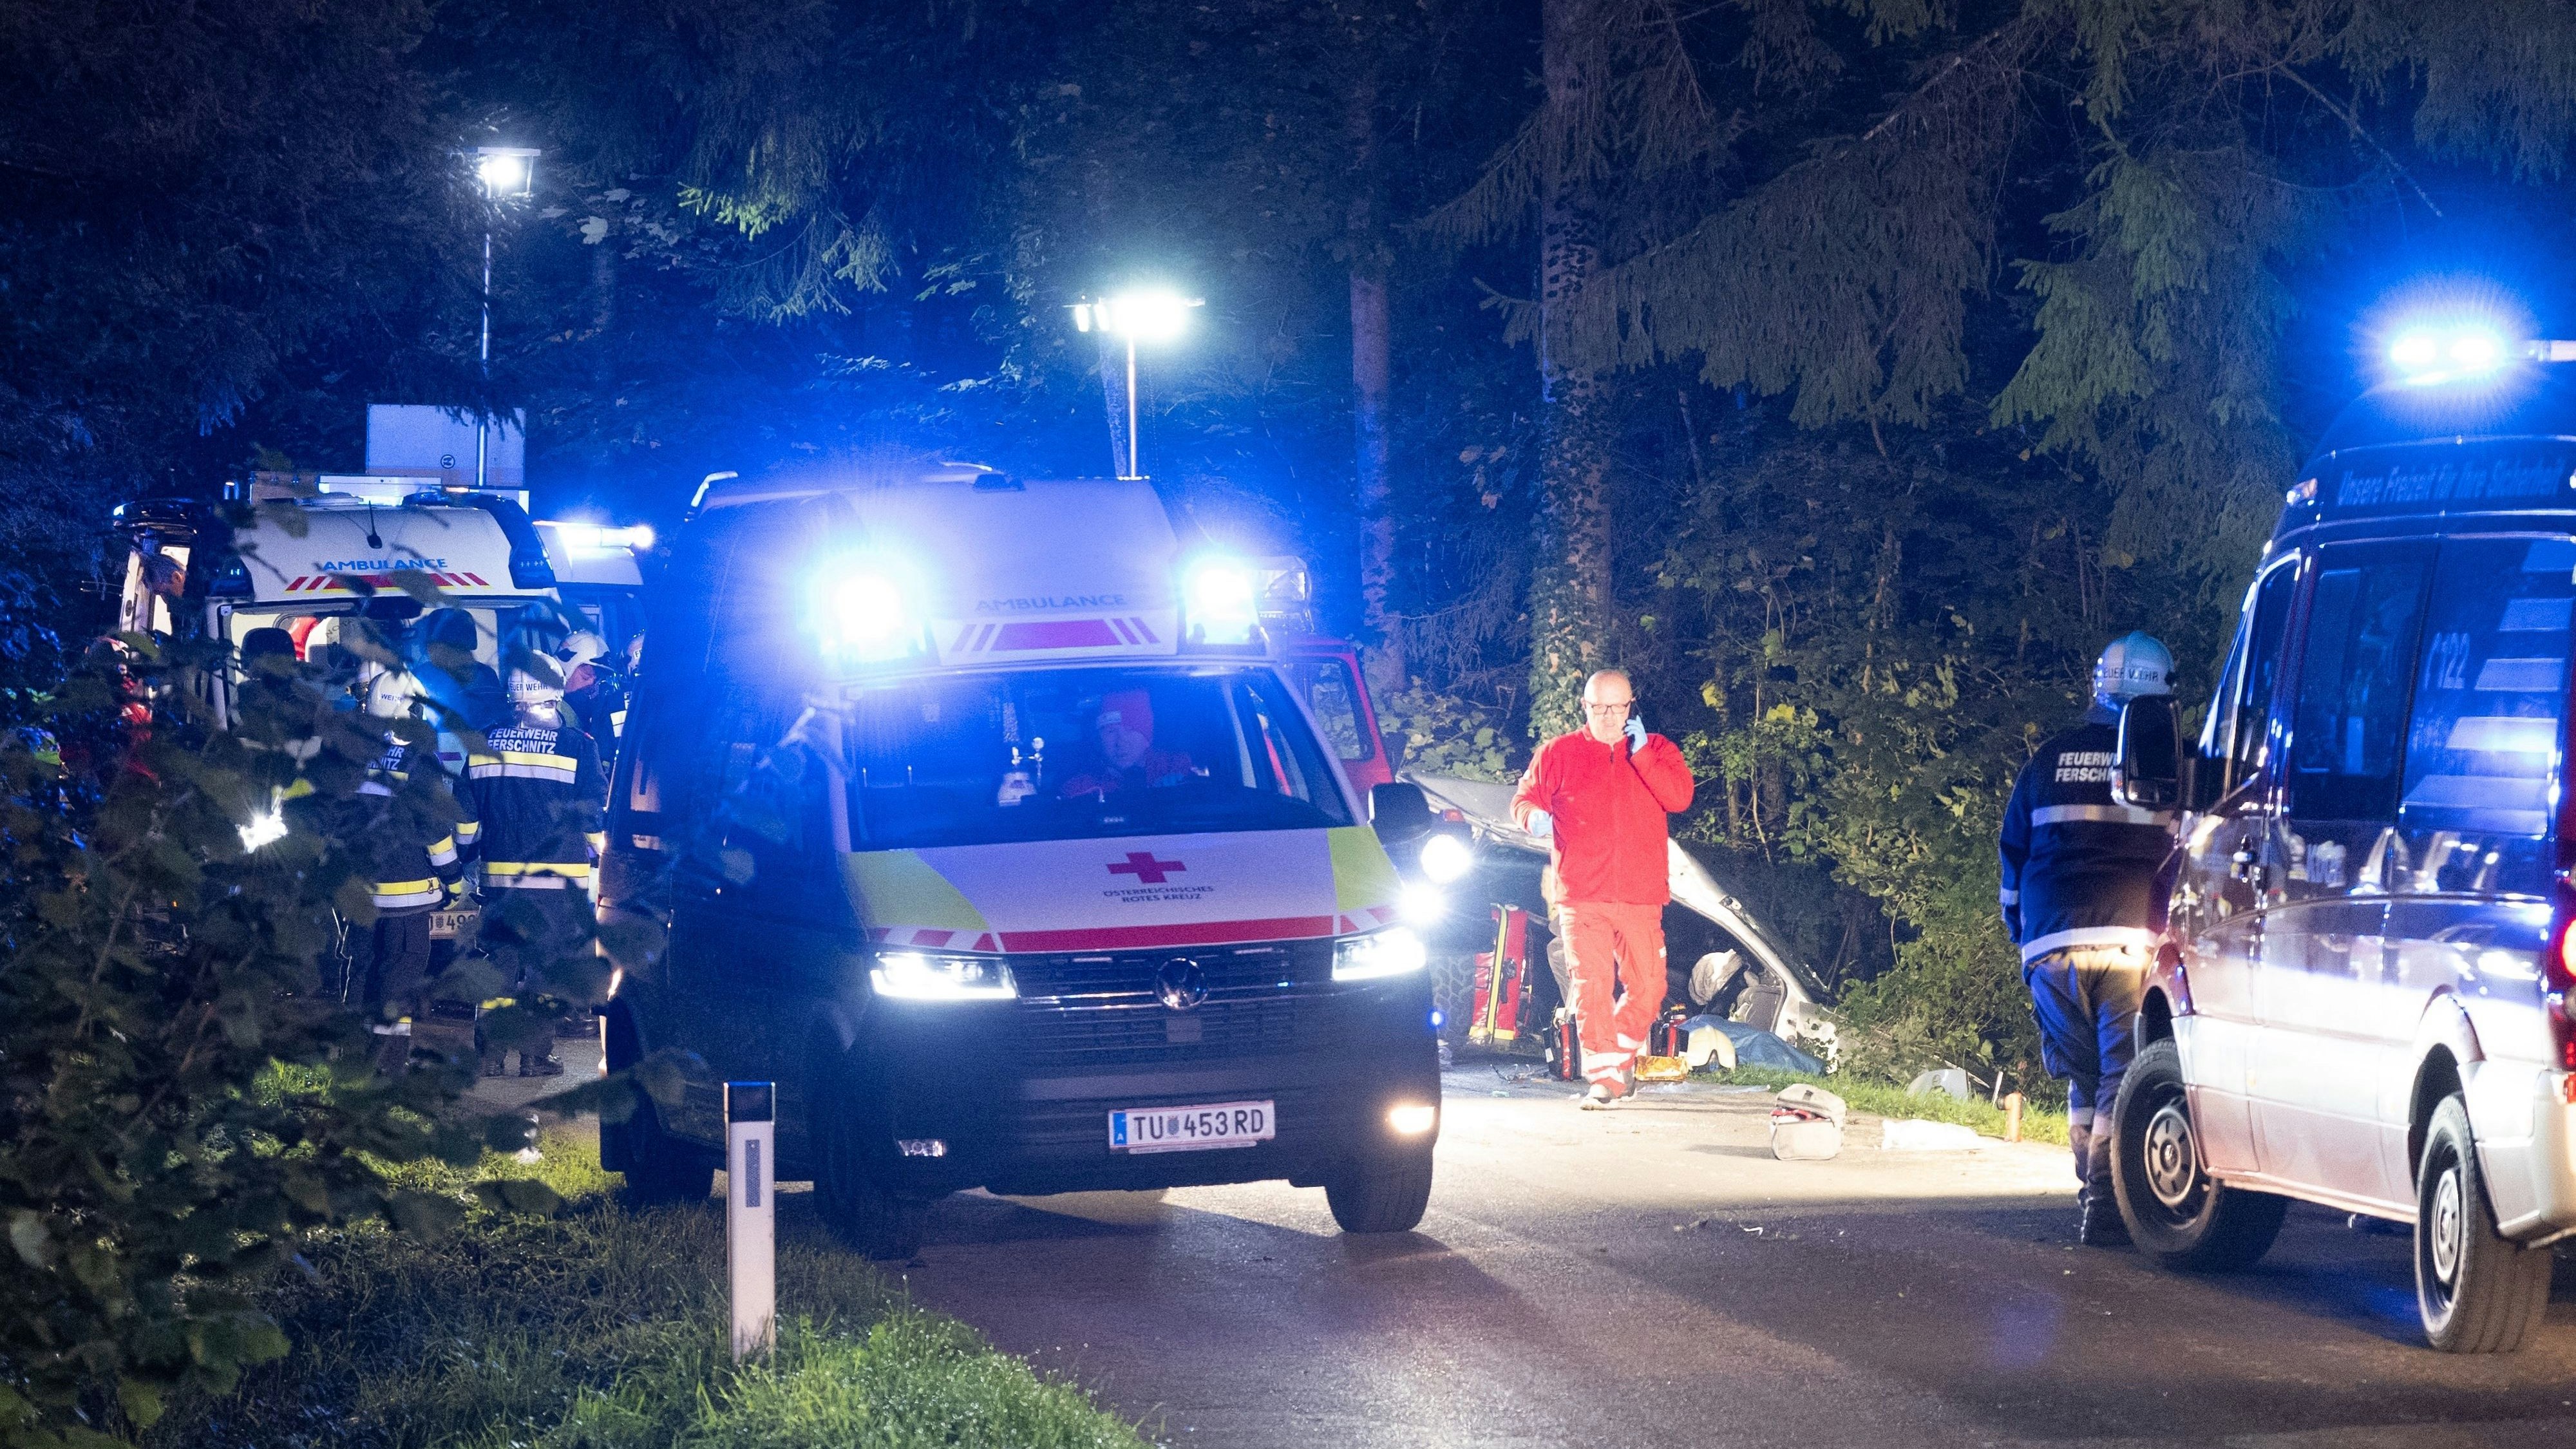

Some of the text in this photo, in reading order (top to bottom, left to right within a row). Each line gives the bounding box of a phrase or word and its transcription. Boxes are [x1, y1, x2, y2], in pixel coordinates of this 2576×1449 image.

[323, 558, 448, 571] AMBULANCE
[976, 594, 1128, 611] AMBULANCE
[489, 728, 558, 741] FEUERWEHR
[488, 739, 556, 754] FERSCHNITZ
[1122, 893, 1202, 903] ROTES KREUZ
[1133, 1115, 1164, 1141] TU
